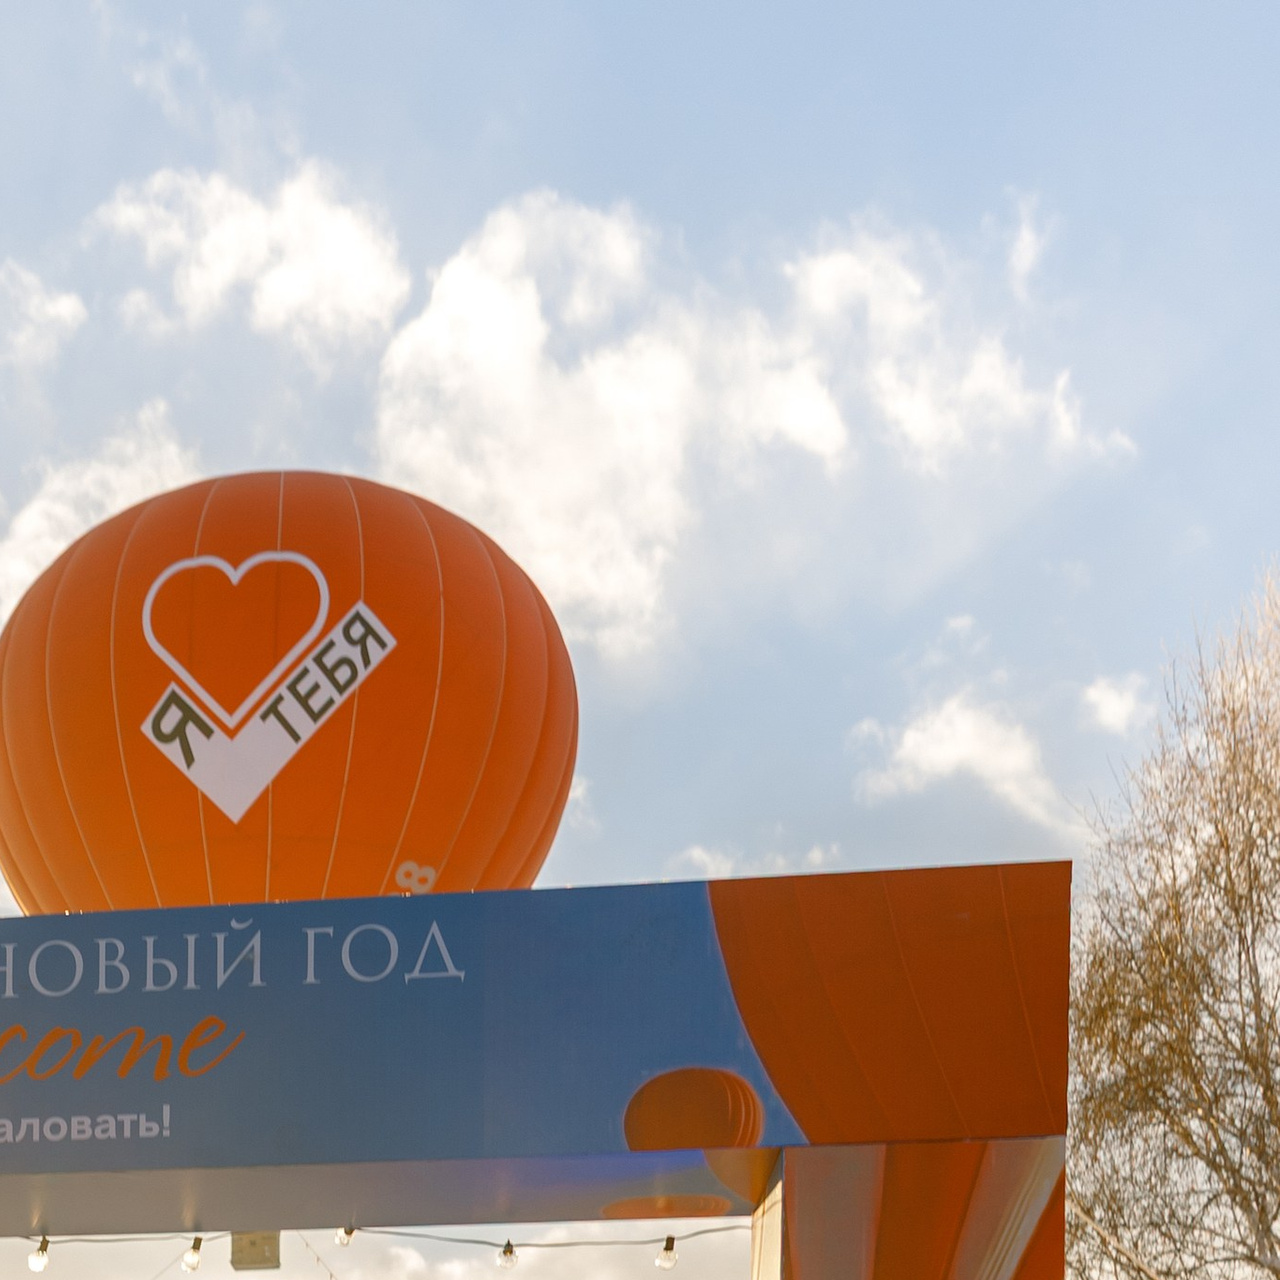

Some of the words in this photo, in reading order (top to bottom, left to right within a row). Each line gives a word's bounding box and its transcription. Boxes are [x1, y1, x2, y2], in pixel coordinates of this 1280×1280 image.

[151, 688, 215, 770] Я
[258, 610, 389, 745] ТЕБЯ
[301, 919, 466, 986] ГОД
